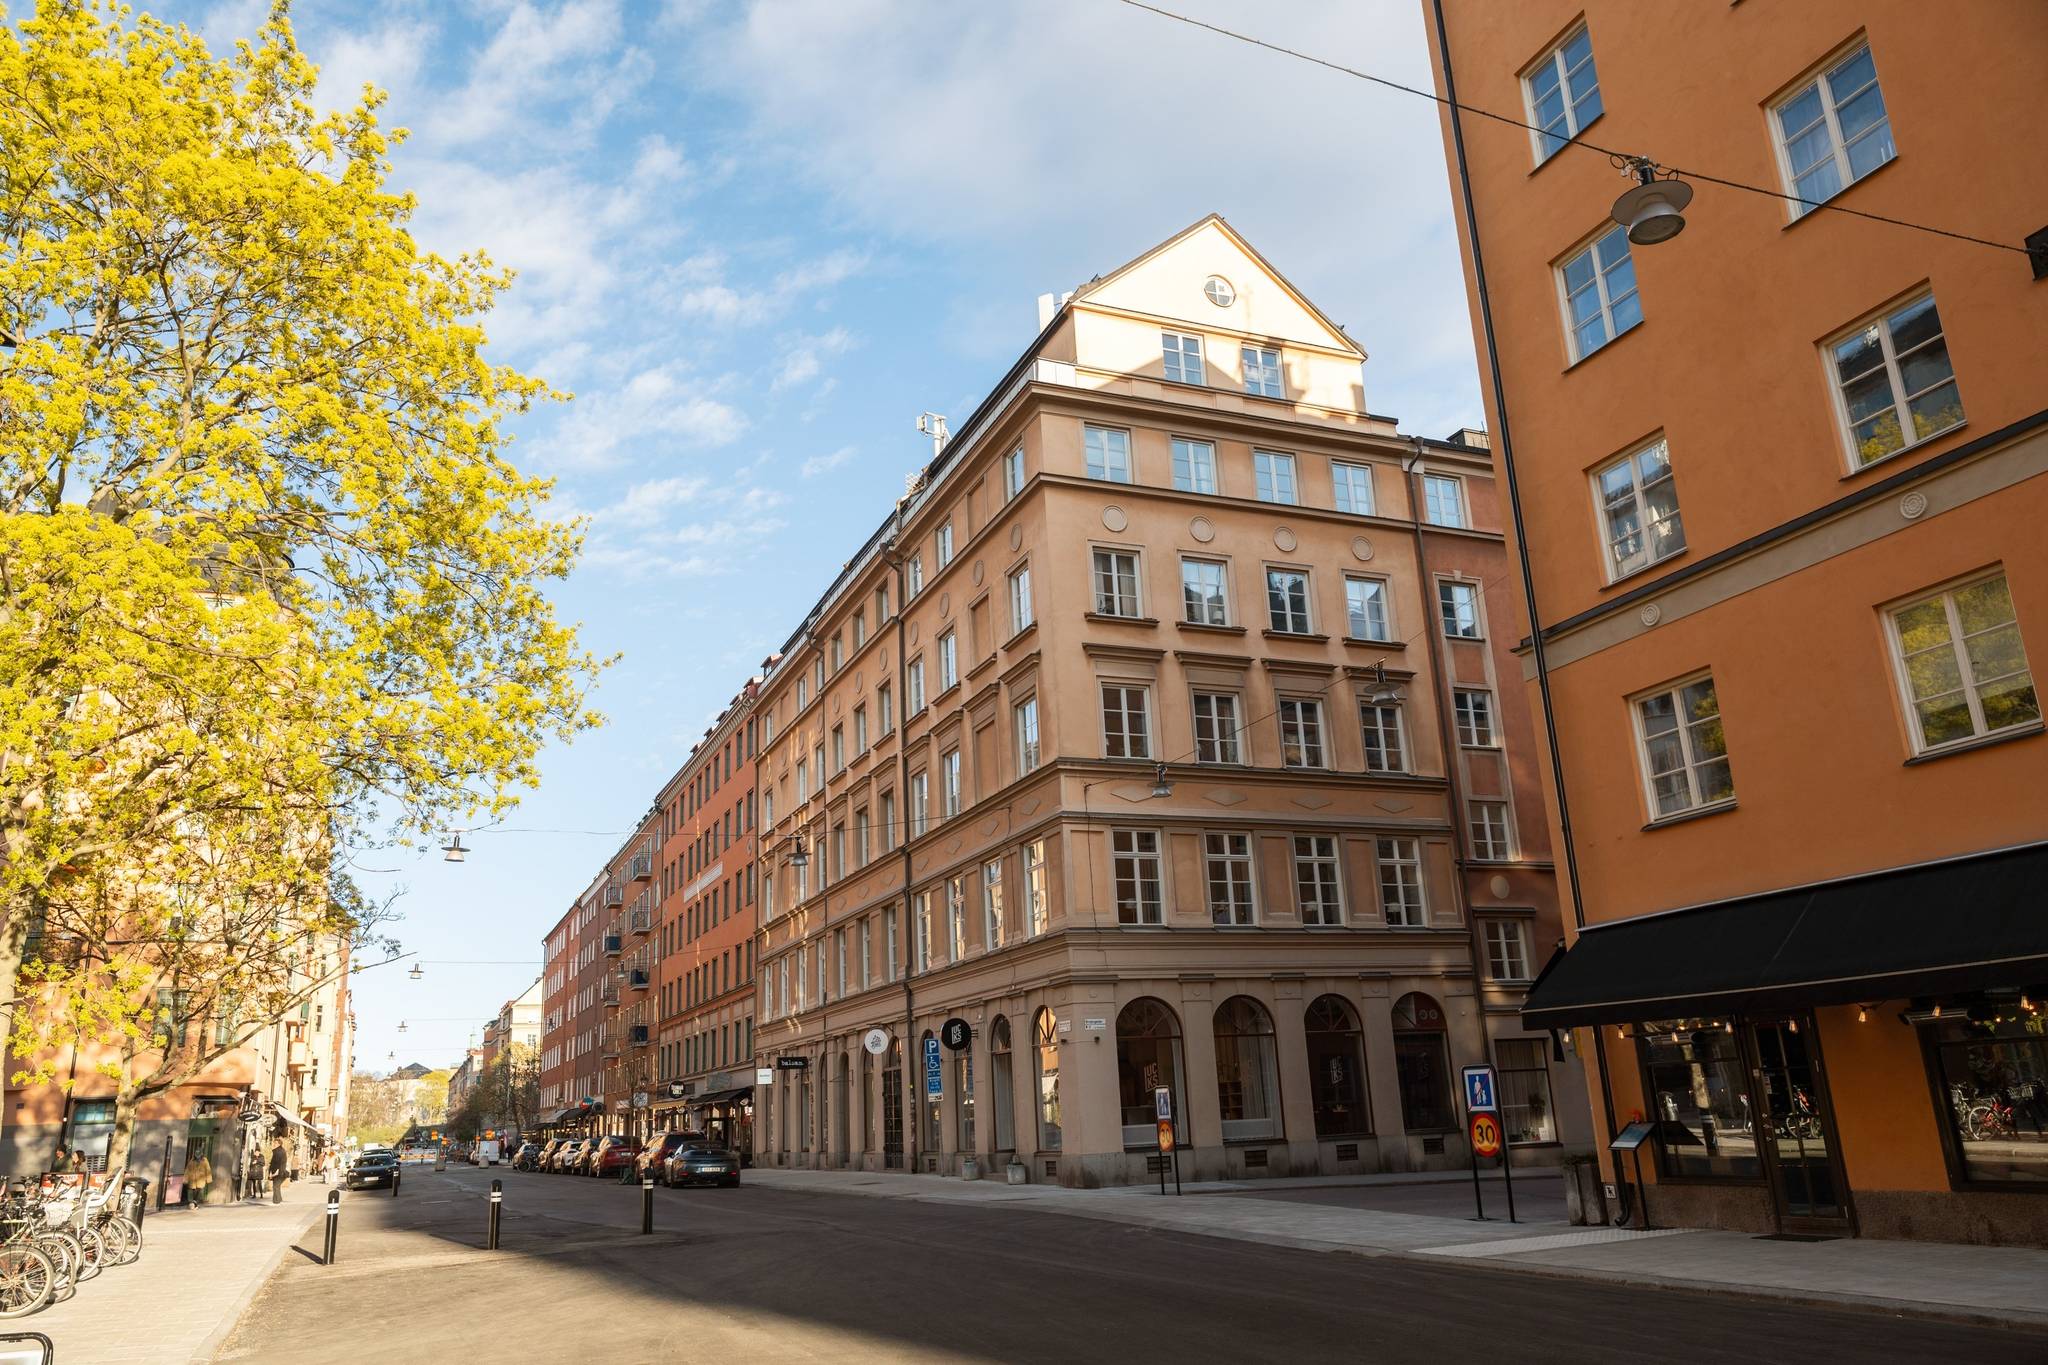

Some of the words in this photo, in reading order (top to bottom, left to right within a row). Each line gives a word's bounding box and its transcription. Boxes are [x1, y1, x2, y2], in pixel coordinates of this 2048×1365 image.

[929, 1041, 937, 1053] P
[1161, 1128, 1171, 1143] 30
[1476, 1124, 1495, 1145] 30
